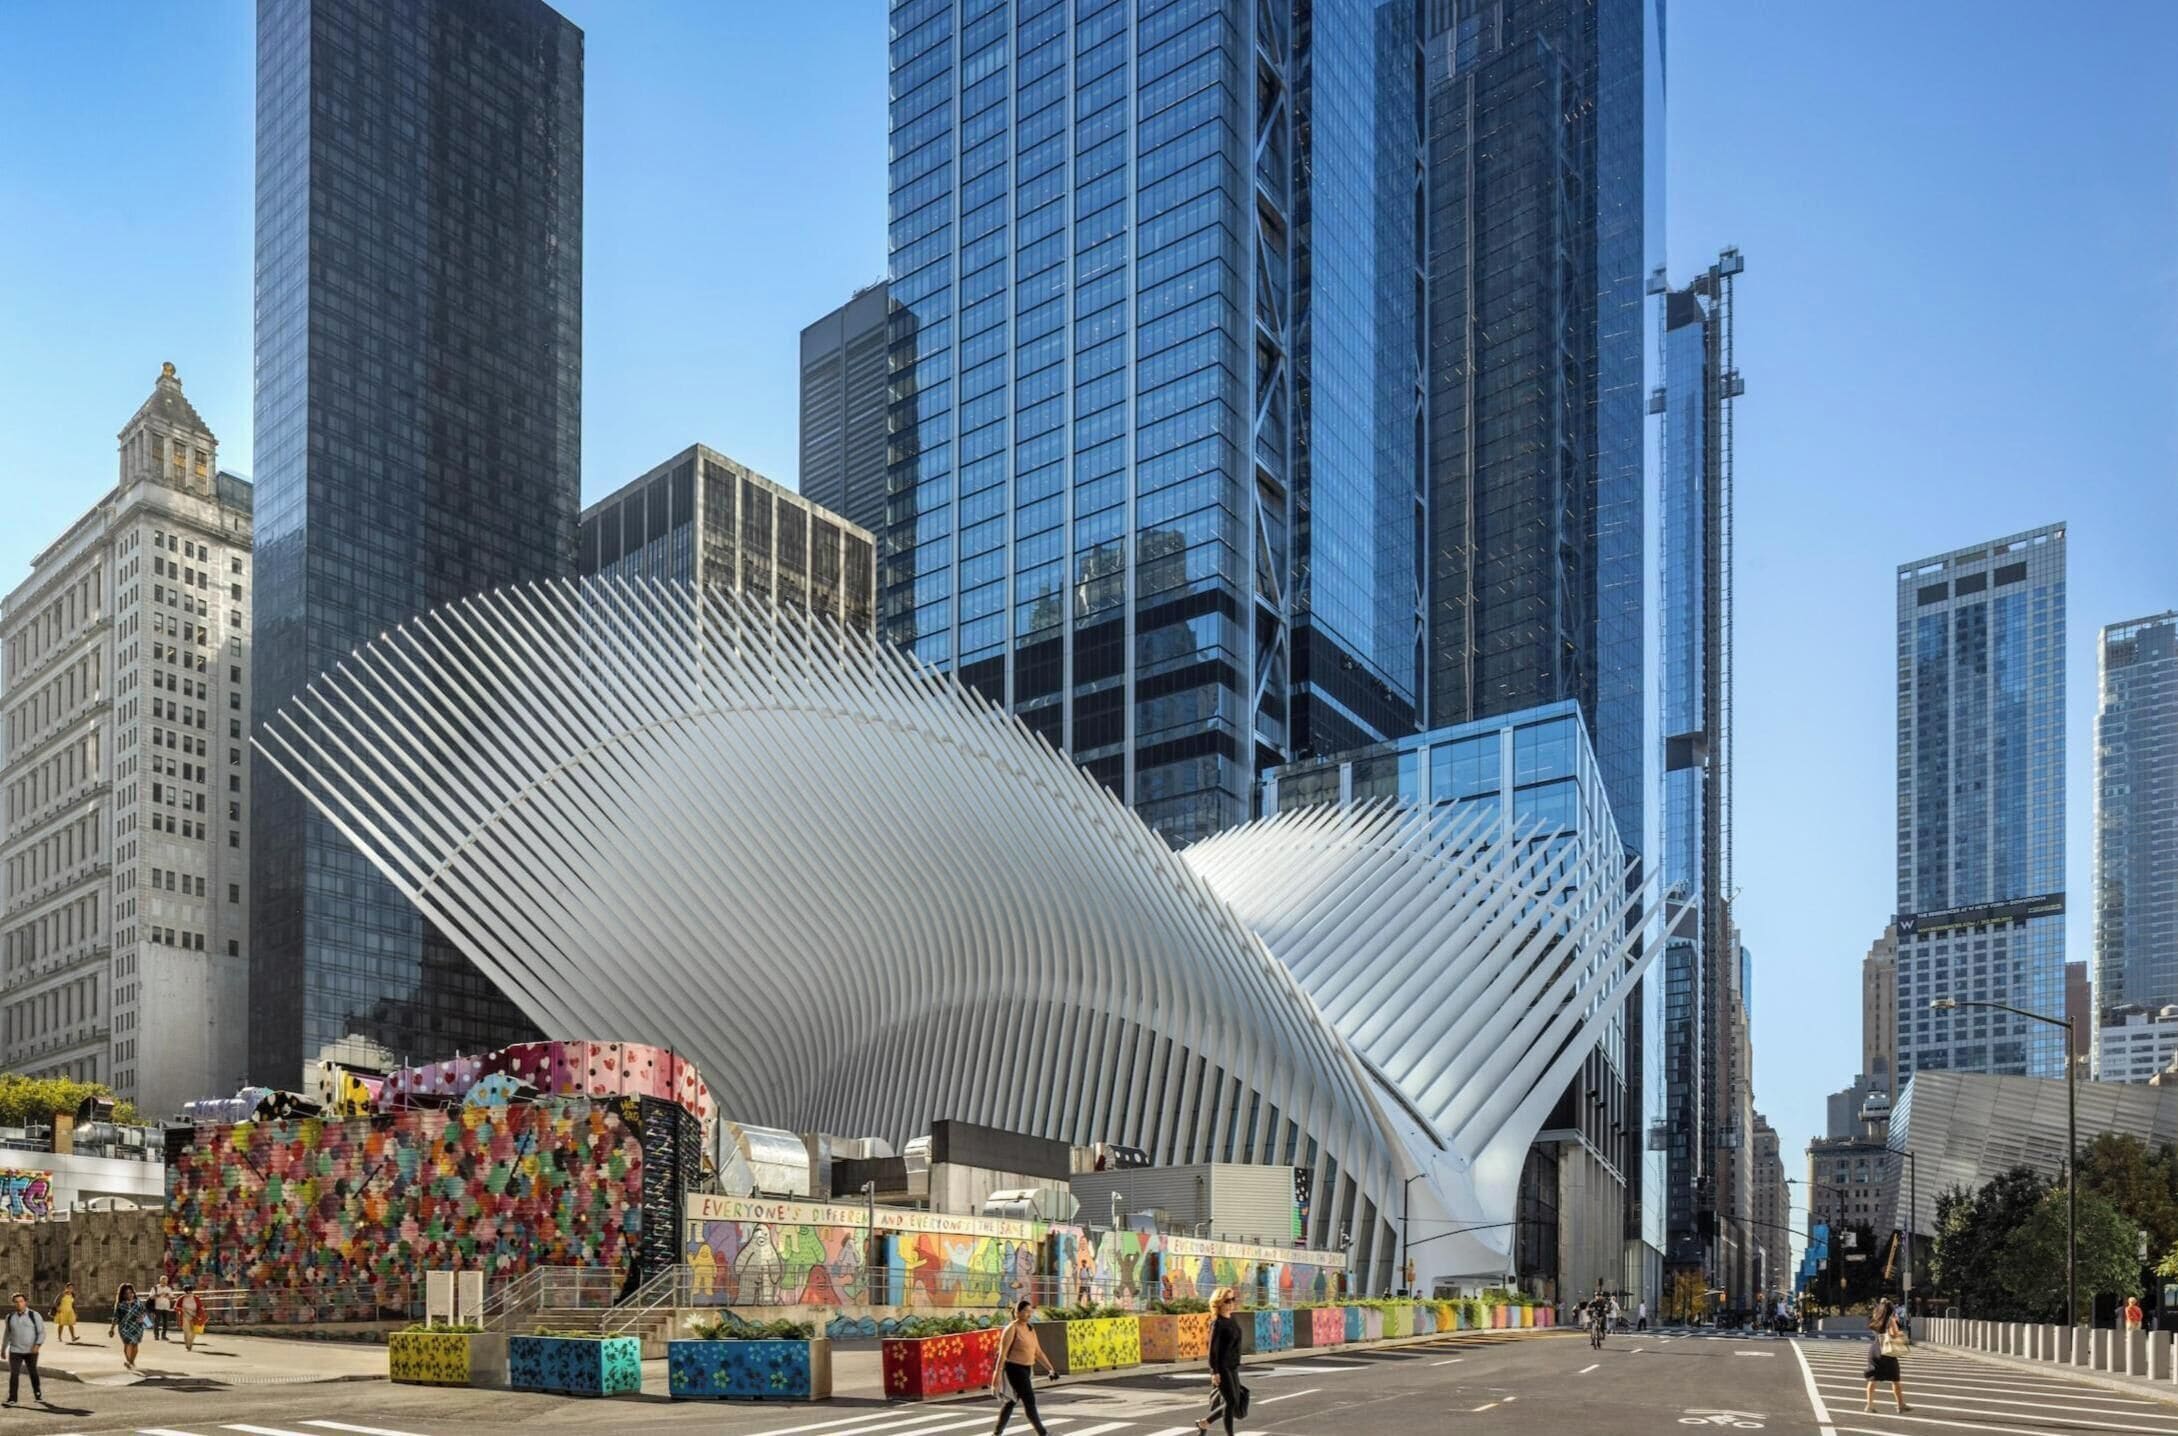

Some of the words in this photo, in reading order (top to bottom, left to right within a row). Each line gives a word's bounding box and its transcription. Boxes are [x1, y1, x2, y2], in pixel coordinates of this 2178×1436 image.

[1900, 919, 1914, 930] W
[702, 1198, 801, 1221] EVERYONE'S
[812, 1208, 869, 1224] DIFFEREN
[881, 1215, 903, 1227] AND
[978, 1219, 994, 1231] THE
[1000, 1221, 1025, 1236] SAME
